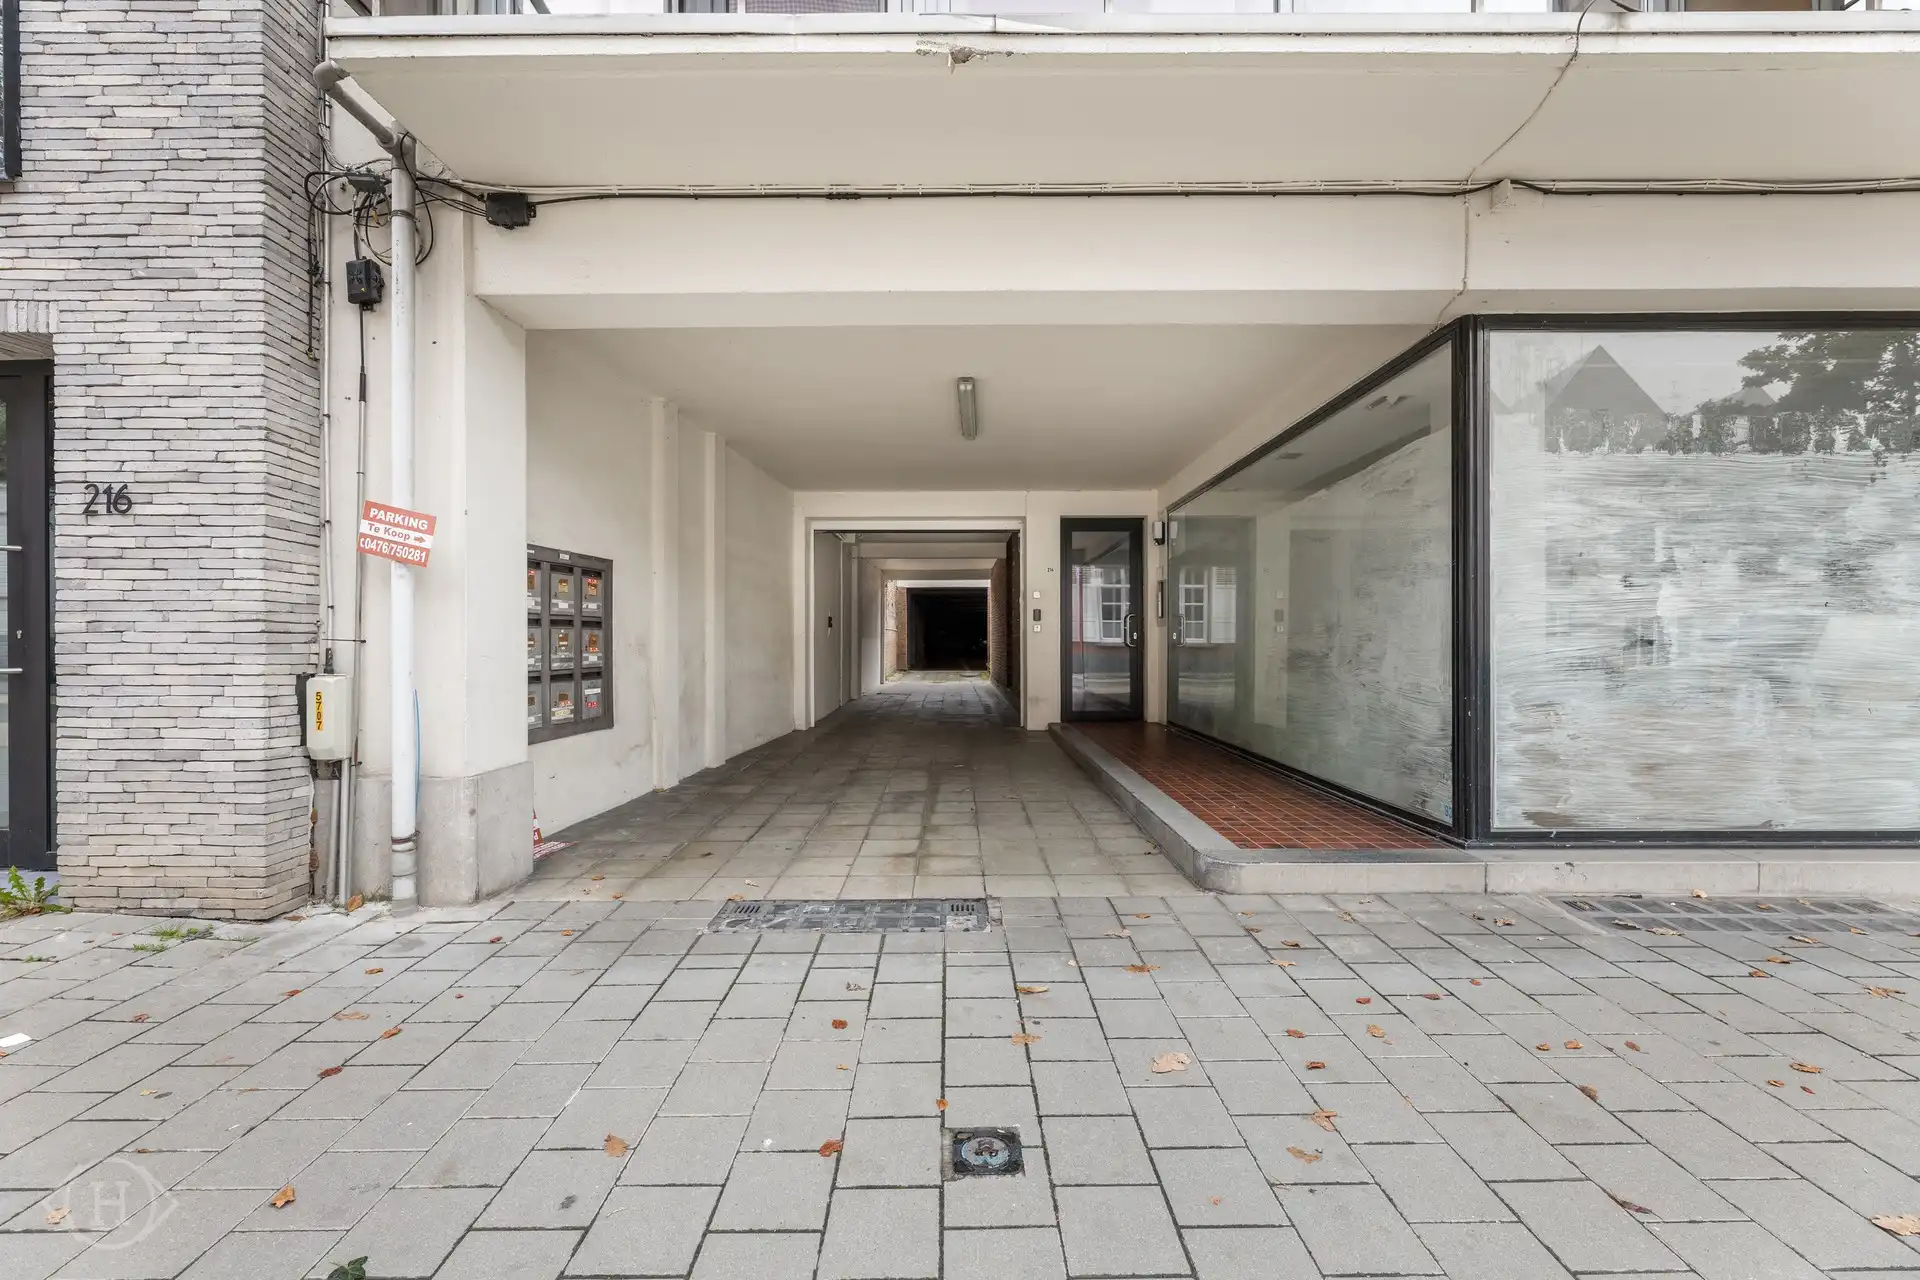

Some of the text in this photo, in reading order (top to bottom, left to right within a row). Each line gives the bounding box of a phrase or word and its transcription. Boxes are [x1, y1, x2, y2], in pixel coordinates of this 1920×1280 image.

[83, 483, 132, 515] 216
[367, 522, 411, 541] Te Koop
[369, 507, 428, 530] PARKING
[315, 691, 323, 731] 5707
